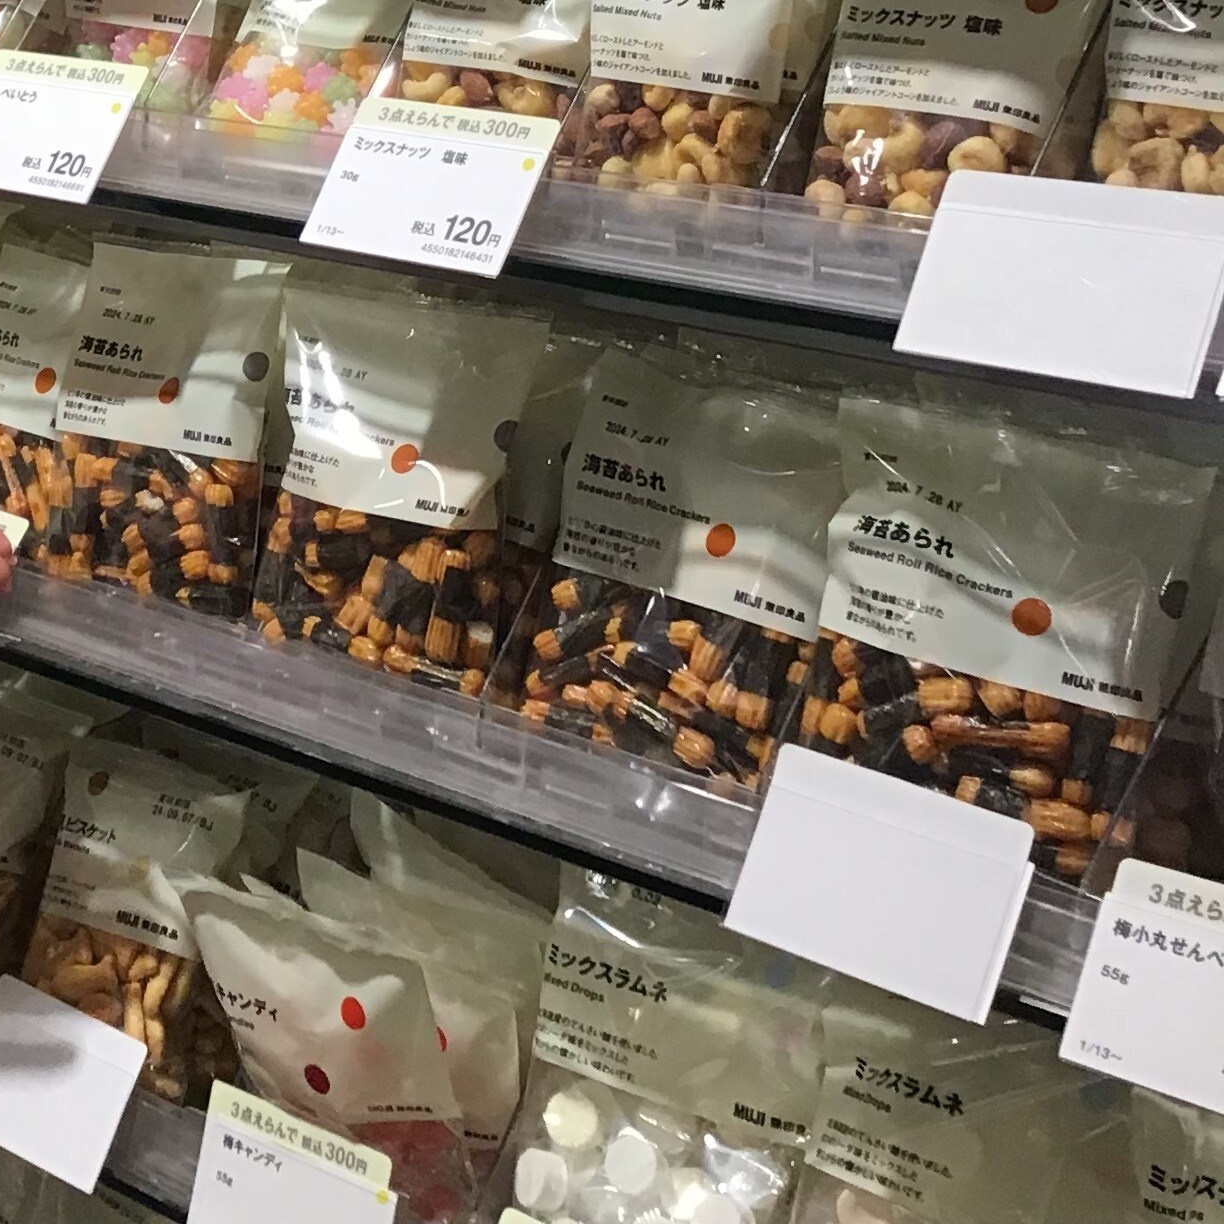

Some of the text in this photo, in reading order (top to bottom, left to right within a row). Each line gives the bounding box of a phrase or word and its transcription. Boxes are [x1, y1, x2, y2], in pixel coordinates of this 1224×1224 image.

[615, 6, 638, 17] Mixed
[640, 9, 662, 21] Nuts
[847, 5, 1003, 37] ミックスナッツ 塩味
[5, 58, 125, 85] 3点えらんで 税込300円
[702, 72, 760, 90] MUJI 無印良品
[378, 107, 530, 140] 3点えらんで 税込300円
[973, 99, 1041, 124] MUJI 無印良品
[21, 150, 93, 179] 税込 120円
[354, 136, 468, 165] ミックスナッツ 塩味
[340, 169, 360, 182] 30g
[410, 214, 502, 248] 税込 120円
[78, 334, 143, 362] 海苔あられ
[581, 452, 666, 493] 海苔あられ
[414, 498, 438, 512] MUJI
[577, 480, 622, 501] Seaweed
[646, 498, 668, 513] Rice
[669, 504, 711, 525] Crackers
[946, 499, 964, 513] AY
[853, 514, 955, 559] 海苔あられ
[848, 541, 1014, 599] Seaweed Roll Rice Crackers
[733, 589, 762, 609] MUJI
[1061, 670, 1094, 692] MUJI
[549, 943, 668, 1003] ミックスラムネ
[1100, 963, 1130, 986] 55g
[570, 982, 605, 1003] Drops
[855, 1056, 964, 1117] ミックスラムネ
[733, 1101, 766, 1126] MUJI
[230, 1100, 369, 1176] 3点えらんで 税込300円
[222, 1134, 283, 1173] 梅キャンディ
